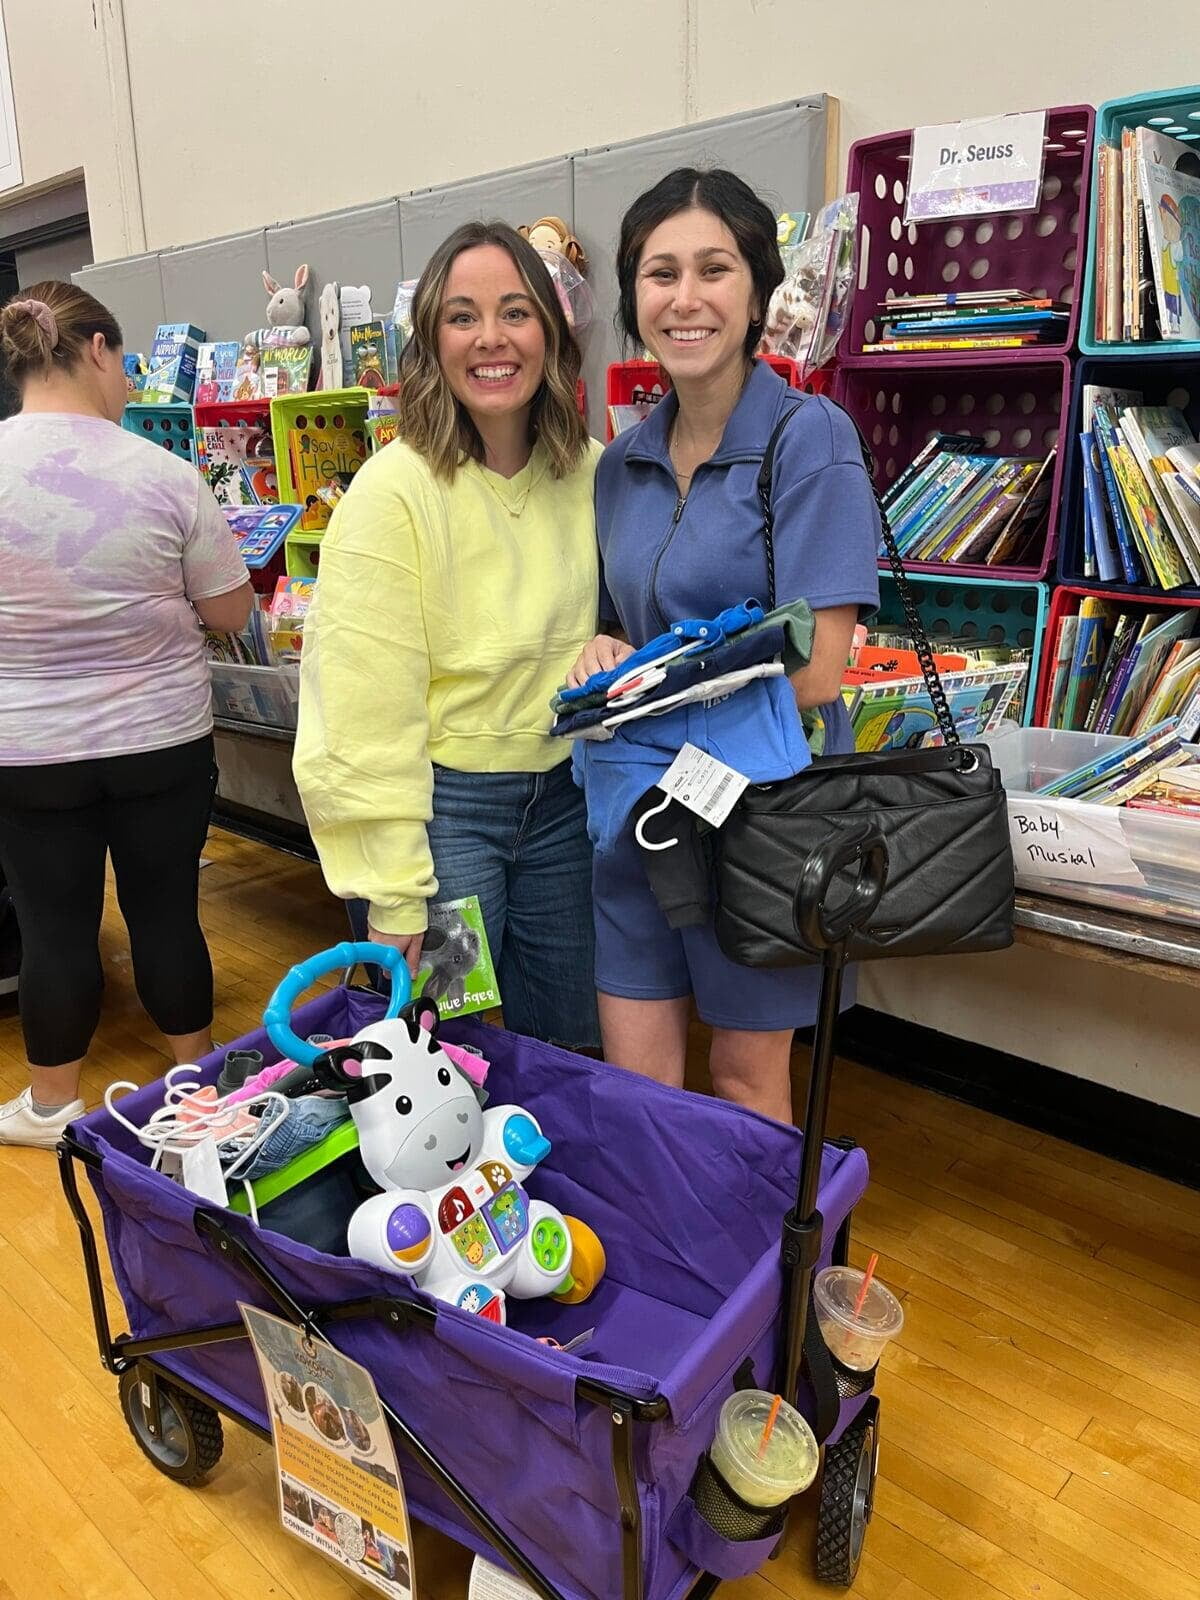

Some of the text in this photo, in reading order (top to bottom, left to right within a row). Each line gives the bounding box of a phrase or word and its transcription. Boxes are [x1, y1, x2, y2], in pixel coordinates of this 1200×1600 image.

[939, 143, 1014, 166] Dr. Seuss
[274, 347, 308, 361] WORLD
[311, 439, 335, 453] Say
[301, 453, 363, 480] Hello
[1081, 624, 1098, 667] A
[1013, 815, 1061, 839] Baby
[462, 989, 496, 1005] Baby
[283, 1516, 314, 1539] CONNECT
[315, 1535, 334, 1550] WITH
